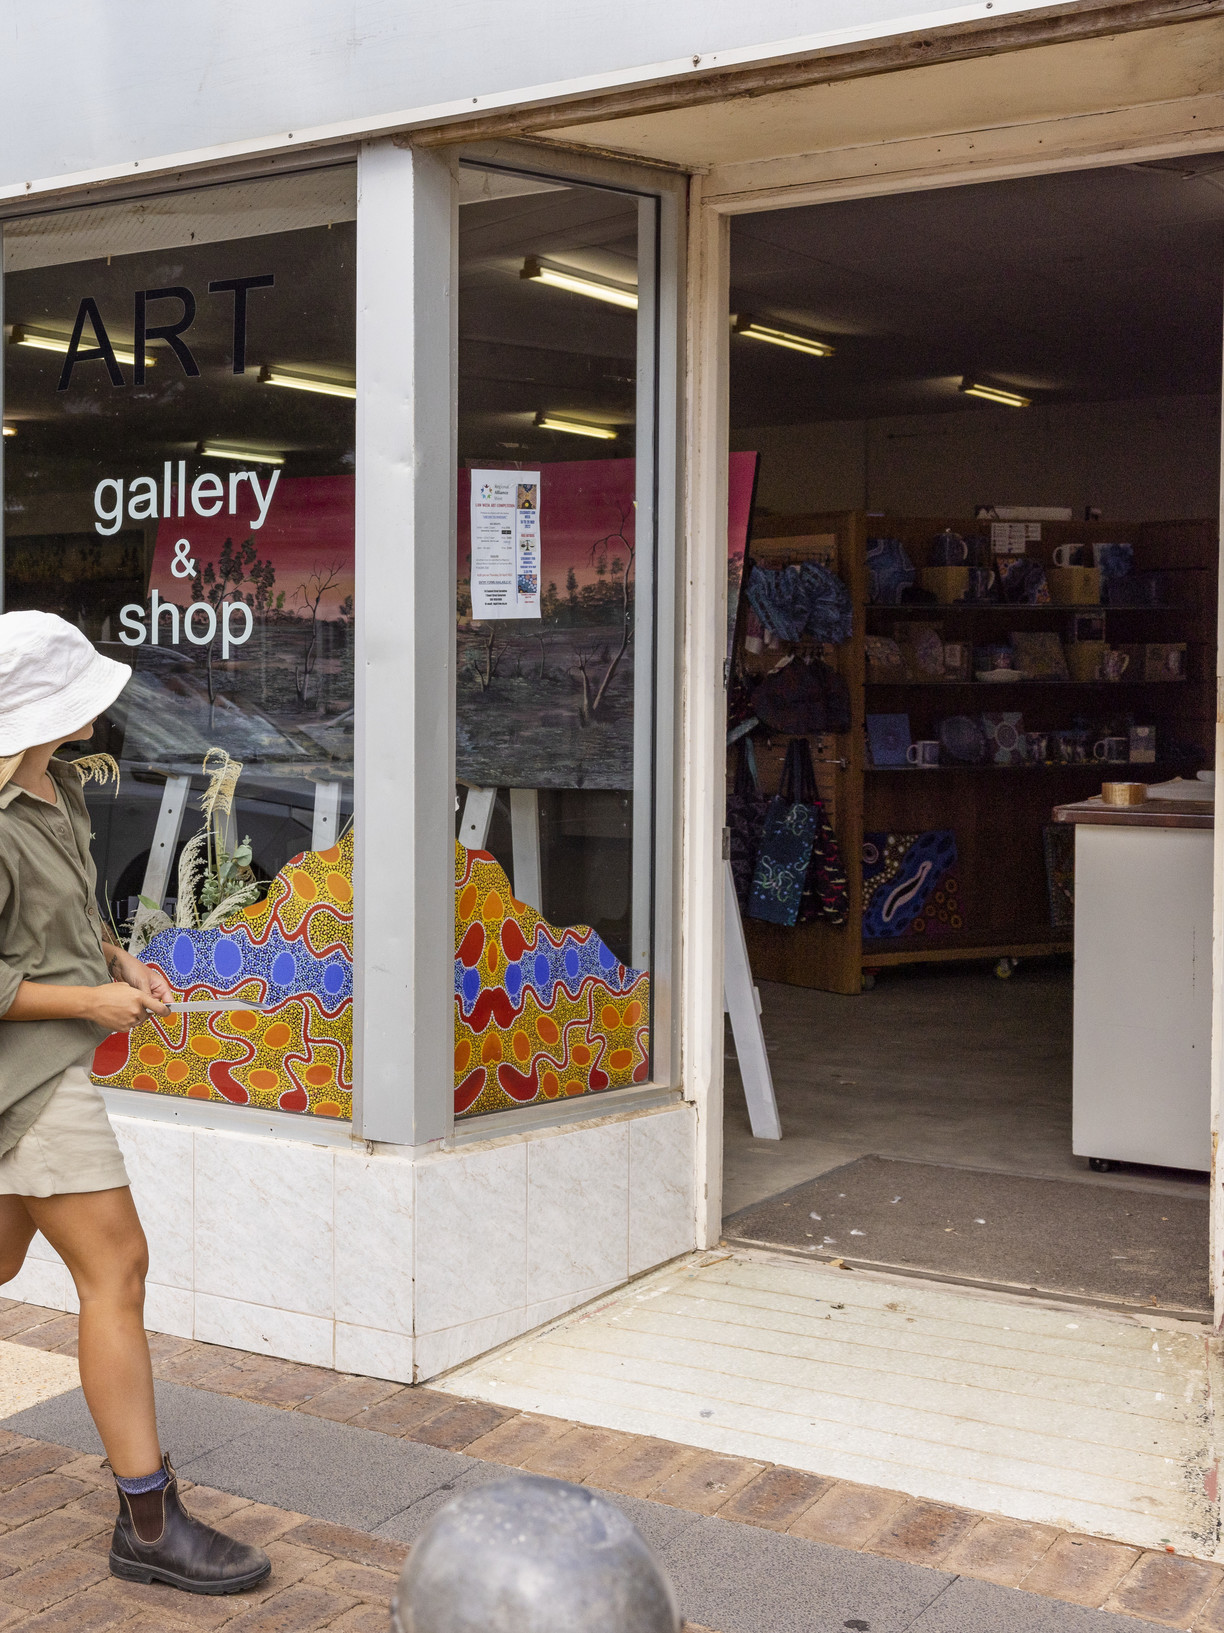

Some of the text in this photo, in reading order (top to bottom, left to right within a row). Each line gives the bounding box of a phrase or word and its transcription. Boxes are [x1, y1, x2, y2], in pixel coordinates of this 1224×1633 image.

[57, 274, 274, 392] ART
[93, 460, 281, 536] gallery
[170, 538, 197, 579] &
[118, 588, 254, 661] shop
